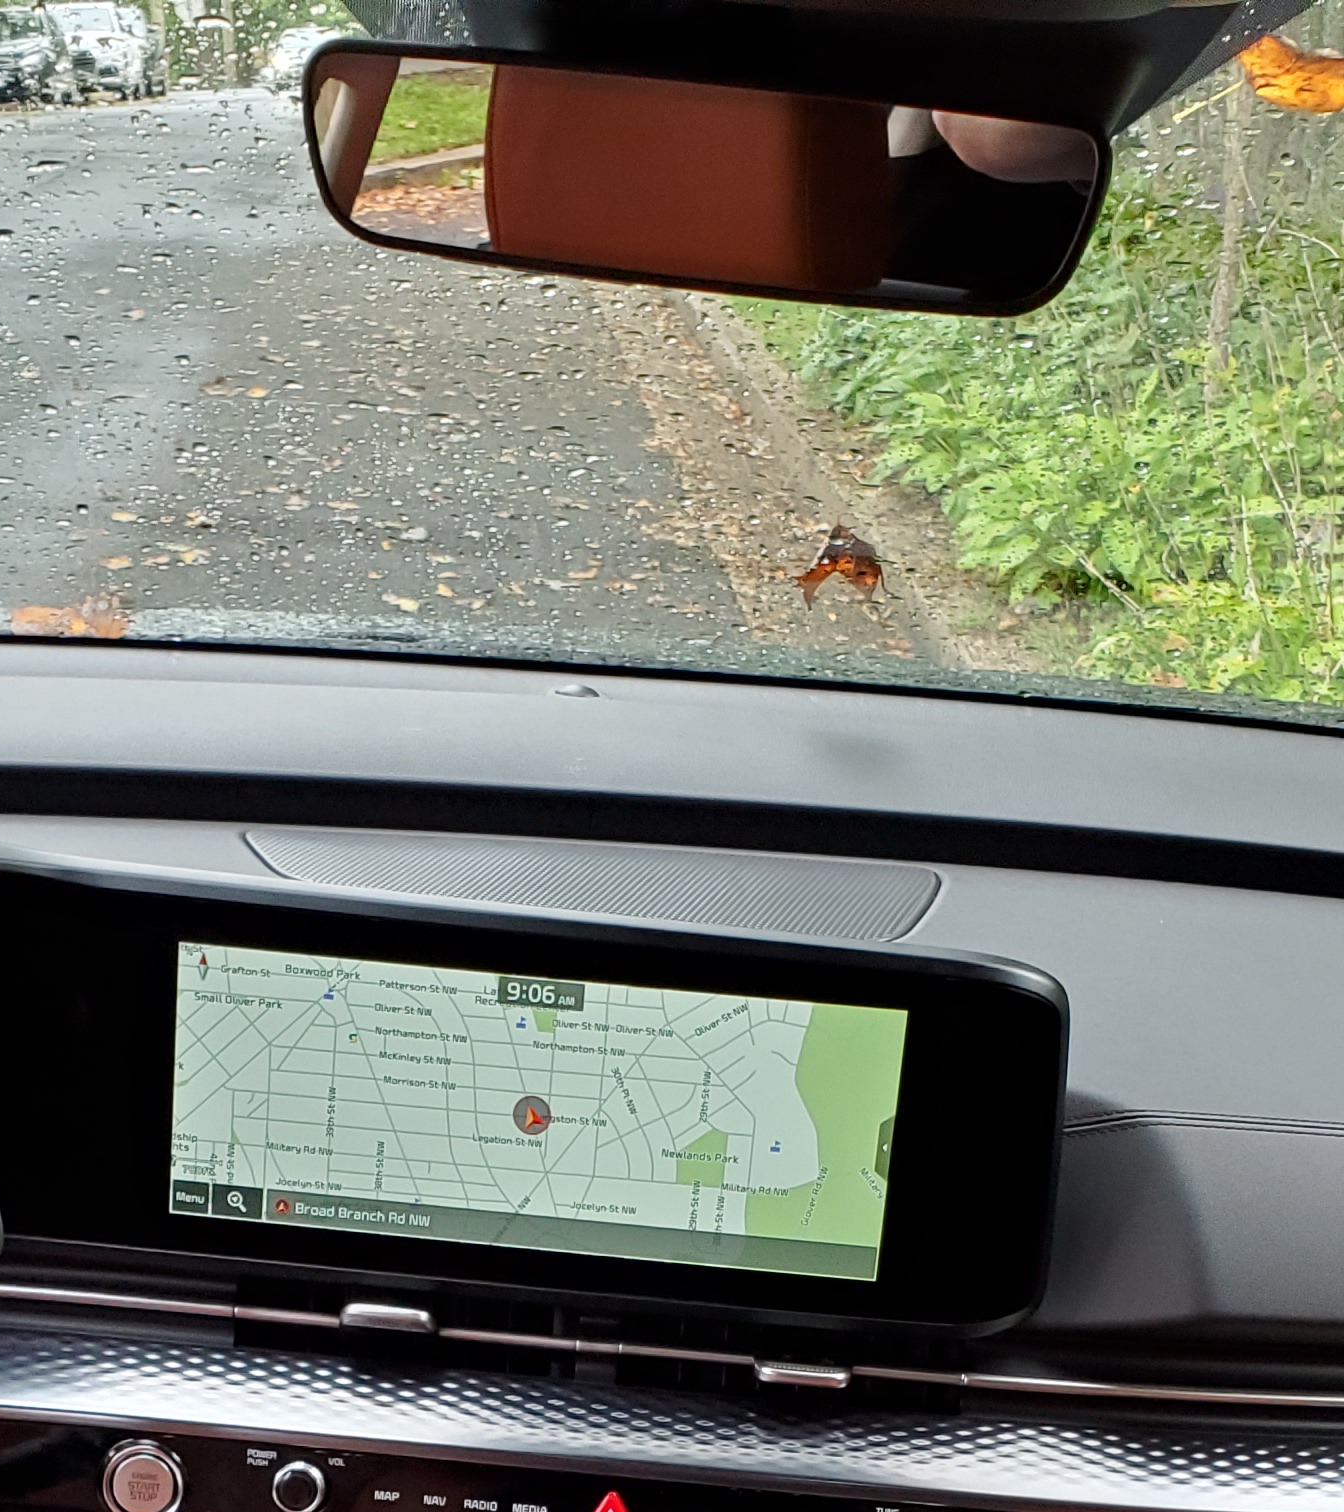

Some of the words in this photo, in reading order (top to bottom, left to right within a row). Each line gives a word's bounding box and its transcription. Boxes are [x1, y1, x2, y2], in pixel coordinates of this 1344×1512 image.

[221, 965, 256, 976] Grafton
[260, 968, 270, 977] St
[285, 964, 333, 977] Boxwood
[336, 970, 361, 980] Park
[379, 980, 427, 993] Patterson
[429, 984, 440, 993] St
[442, 985, 457, 995] NW
[507, 982, 555, 1004] 9:06
[558, 996, 575, 1007] AM
[194, 992, 222, 1003] Small
[258, 999, 283, 1009] Park
[374, 1003, 402, 1014] Oliver
[404, 1006, 415, 1015] St
[417, 1008, 432, 1017] NW
[552, 1019, 579, 1030] Oliver
[581, 1022, 592, 1031] St
[594, 1023, 609, 1032] NW
[695, 1020, 721, 1037] Oliver
[721, 1012, 731, 1023] St
[731, 1003, 749, 1018] NW
[375, 1027, 438, 1041] Northampton
[440, 1033, 450, 1042] St
[453, 1034, 467, 1043] NW
[615, 1025, 643, 1036] Oliver
[645, 1027, 656, 1036] St
[658, 1029, 674, 1038] NW
[532, 1041, 594, 1055] Northampton
[597, 1047, 607, 1055] St
[610, 1048, 625, 1057] NW
[378, 1051, 421, 1064] McKinley
[423, 1055, 434, 1064] St
[436, 1057, 451, 1065] NW
[383, 1076, 426, 1088] Morrison
[429, 1080, 439, 1088] St
[441, 1081, 456, 1090] NW
[702, 1071, 711, 1086] NW
[328, 1087, 336, 1101] NW
[610, 1067, 625, 1088] 30th
[626, 1100, 637, 1115] NW
[701, 1089, 710, 1101] St
[327, 1104, 335, 1115] St
[699, 1102, 708, 1123] 29th
[326, 1117, 334, 1138] 39th
[579, 1117, 589, 1125] St
[592, 1118, 607, 1127] NW
[472, 1133, 512, 1146] Legation
[515, 1138, 525, 1146] St
[527, 1139, 542, 1148] NW
[266, 1142, 301, 1155] Military
[304, 1145, 316, 1154] Rd
[318, 1148, 333, 1156] NW
[377, 1141, 385, 1155] NW
[376, 1158, 384, 1169] St
[661, 1149, 711, 1162] Newlands
[714, 1154, 739, 1164] Park
[276, 1178, 311, 1190] Jocelyn
[313, 1181, 324, 1190] St
[327, 1183, 342, 1191] NW
[374, 1169, 383, 1190] 38th
[859, 1168, 884, 1199] Military
[692, 1180, 700, 1195] NW
[721, 1183, 757, 1195] Military
[759, 1186, 771, 1195] Rd
[773, 1187, 788, 1196] NW
[176, 1191, 205, 1204] Menu
[517, 1195, 531, 1211] NW
[690, 1197, 699, 1209] St
[716, 1194, 725, 1210] NW
[801, 1196, 817, 1226] Glover
[812, 1182, 822, 1196] Rd
[817, 1166, 828, 1181] NW
[295, 1203, 335, 1218] Broad
[338, 1207, 385, 1223] Branch
[388, 1213, 406, 1225] Rd
[409, 1214, 431, 1227] NW
[570, 1201, 606, 1213] Jocelyn
[609, 1205, 620, 1213] St
[622, 1206, 637, 1215] NW
[688, 1210, 697, 1231] 29th
[715, 1210, 723, 1222] St
[247, 1449, 277, 1459] POWER
[247, 1457, 269, 1466] PUSH
[328, 1457, 346, 1467] VOL
[128, 1481, 160, 1492] START
[130, 1491, 158, 1502] STOP
[374, 1490, 400, 1502] MAP
[423, 1495, 446, 1507] NAV
[464, 1499, 498, 1512] RADIO
